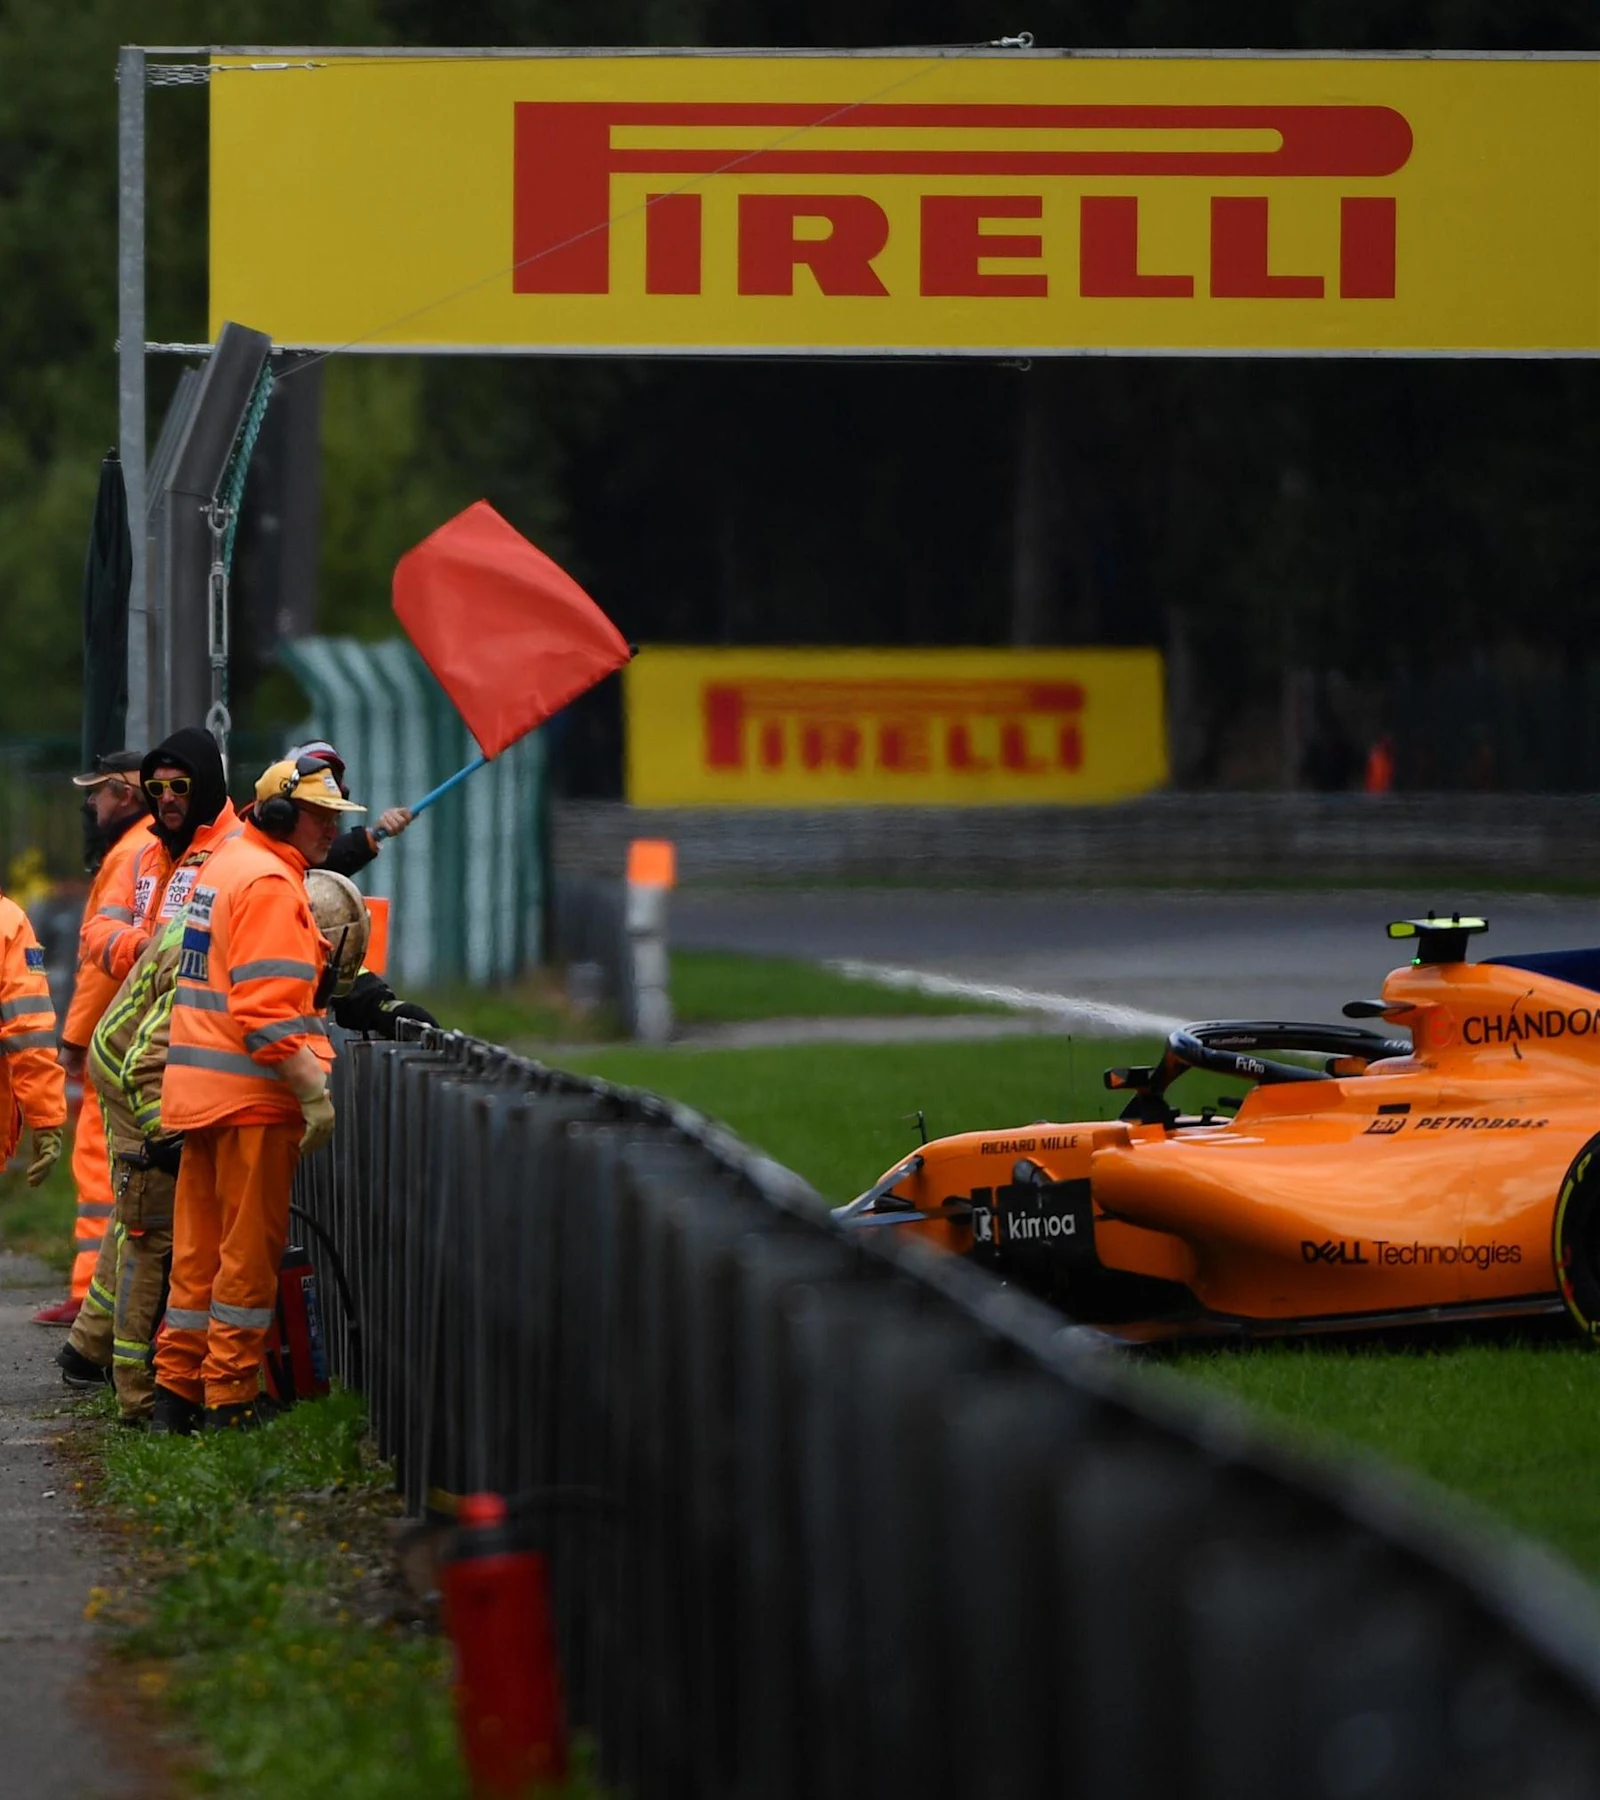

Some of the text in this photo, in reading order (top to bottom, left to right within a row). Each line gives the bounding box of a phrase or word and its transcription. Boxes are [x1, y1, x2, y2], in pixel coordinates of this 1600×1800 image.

[514, 102, 1413, 299] PIRELLI
[704, 680, 1084, 771] PIRELLI
[1413, 1116, 1550, 1131] PETROBRAS
[981, 1134, 1079, 1155] RICHARD MILLE
[1008, 1210, 1076, 1240] kimoa
[1300, 1238, 1522, 1271] DELL Technologies
